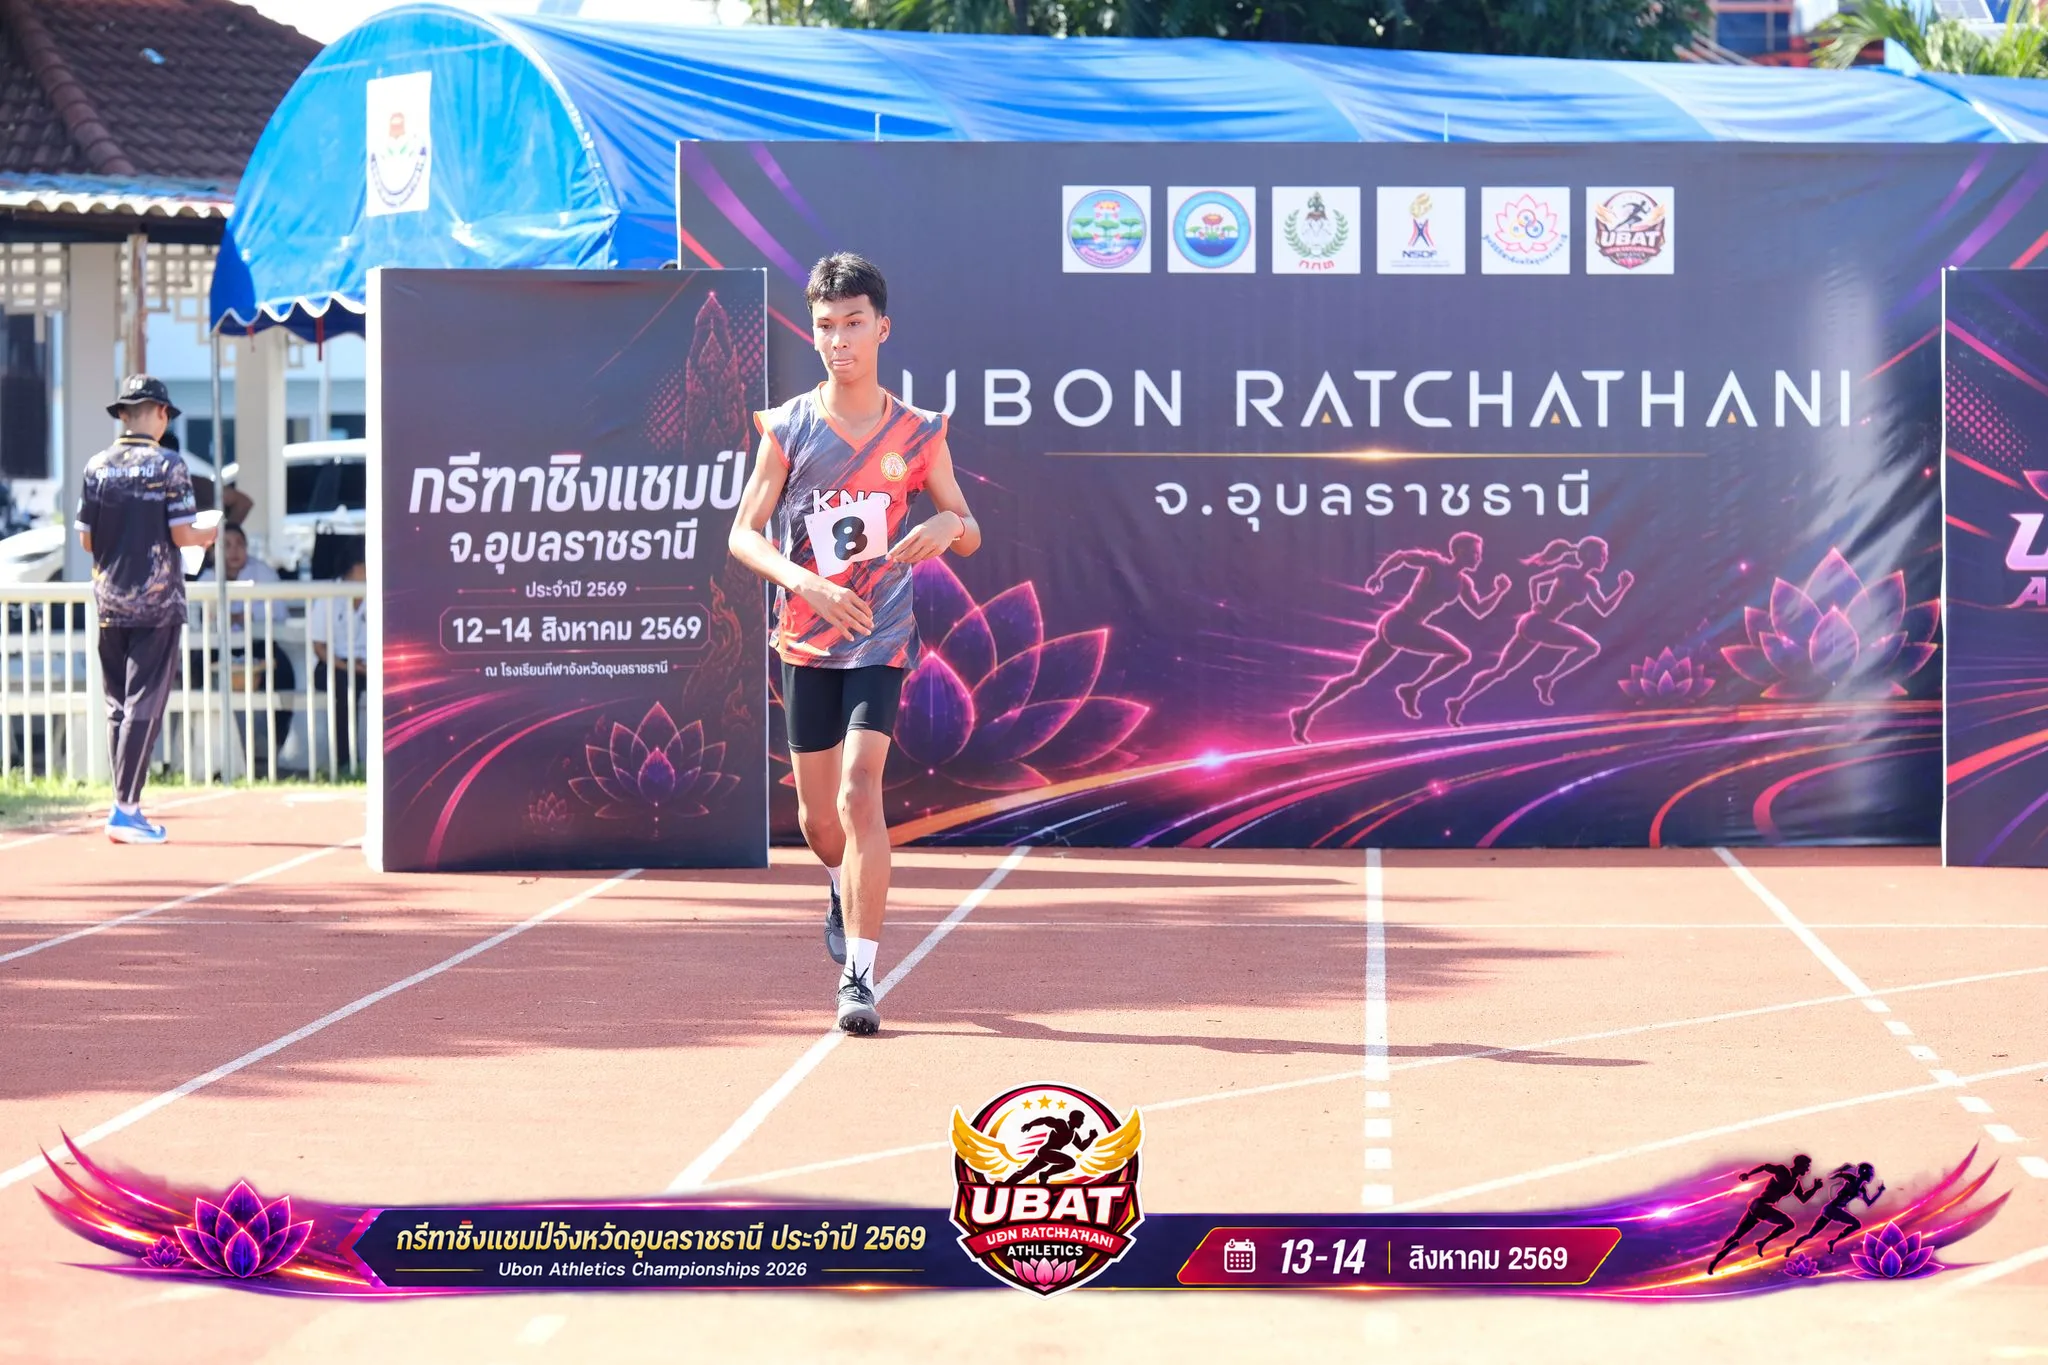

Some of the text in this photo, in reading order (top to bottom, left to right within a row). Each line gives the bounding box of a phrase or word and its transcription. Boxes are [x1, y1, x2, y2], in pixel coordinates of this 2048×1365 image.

[1600, 231, 1661, 247] UBAT
[902, 368, 1850, 428] UBON RATCHATHANI
[1155, 469, 1589, 532] จ.อุบลราชธานี
[449, 518, 699, 575] จ.อุบลราชธานี
[831, 515, 869, 561] 8
[525, 580, 628, 598] ประจำปี 2569
[541, 616, 632, 642] สิงหาคม
[641, 616, 702, 640] 2569
[485, 666, 498, 677] ณ
